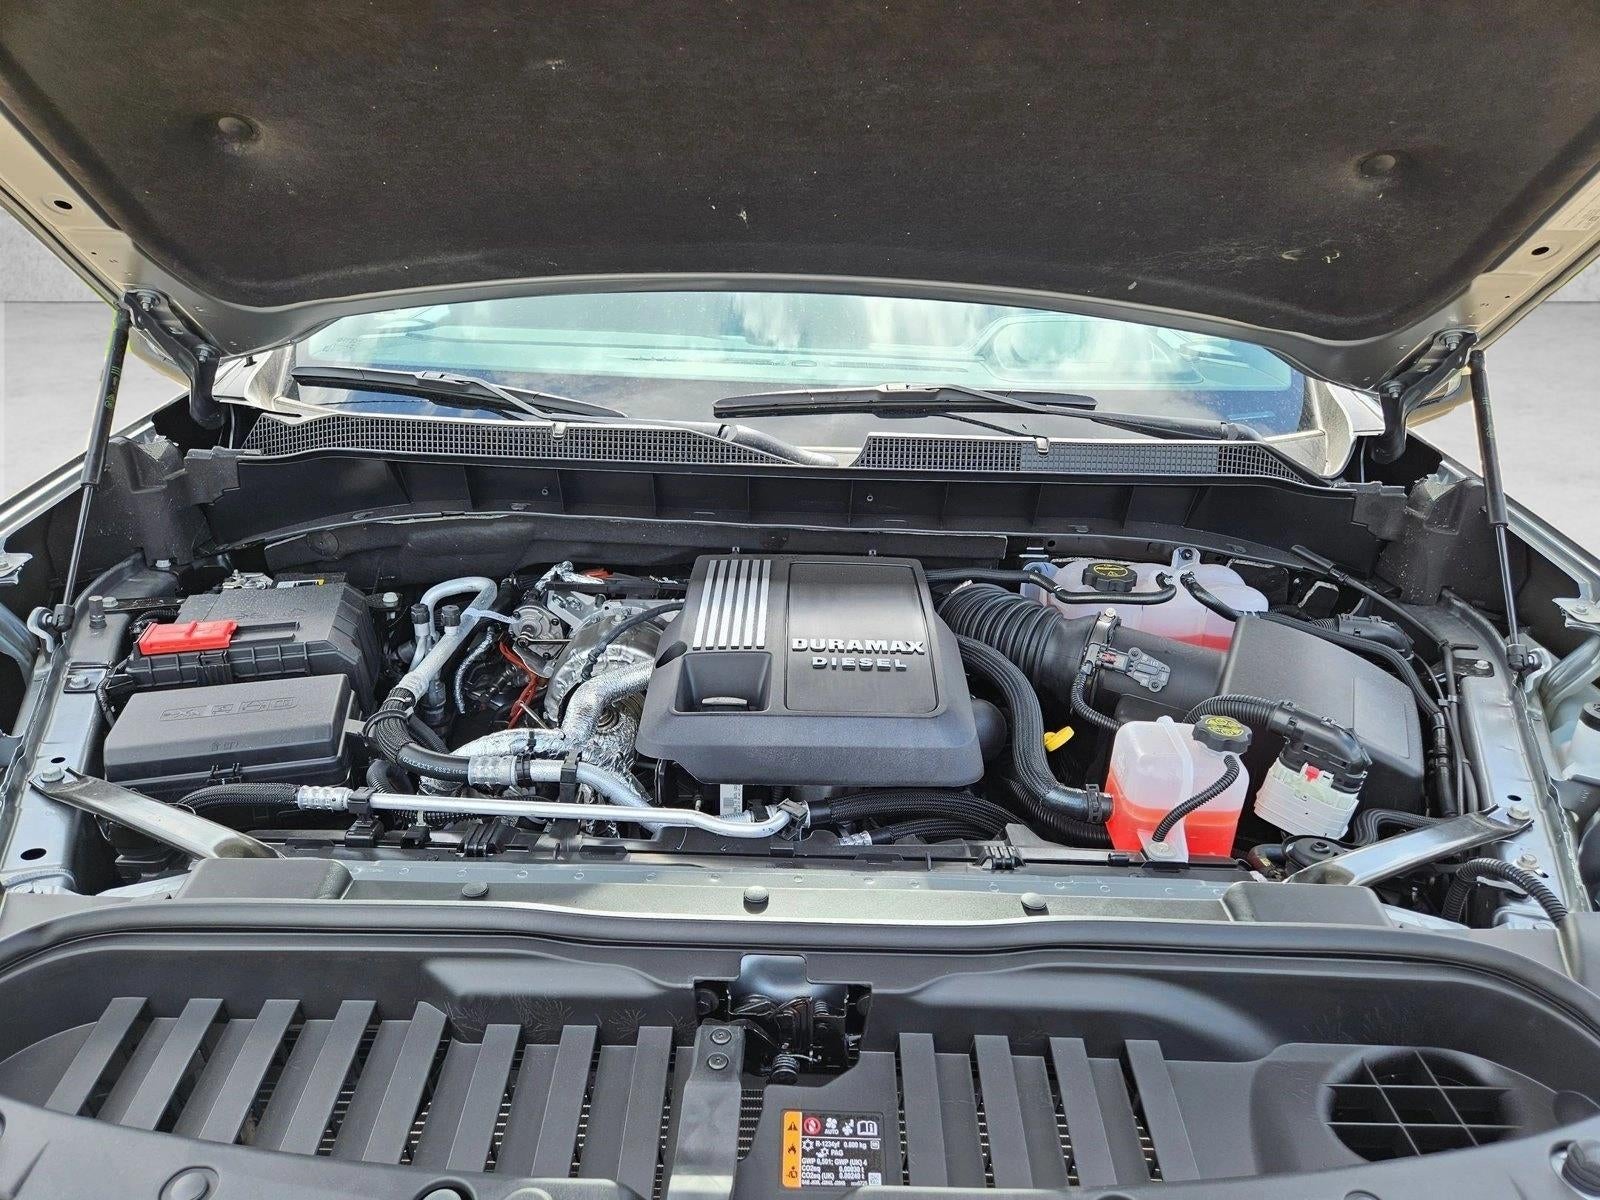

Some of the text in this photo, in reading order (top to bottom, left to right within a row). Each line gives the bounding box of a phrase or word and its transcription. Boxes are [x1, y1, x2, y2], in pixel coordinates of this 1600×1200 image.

[792, 638, 925, 655] DURAMAX
[812, 656, 907, 672] DIESEL
[824, 1128, 840, 1136] AUTO
[859, 1141, 867, 1150] kg
[830, 1149, 844, 1157] PAG
